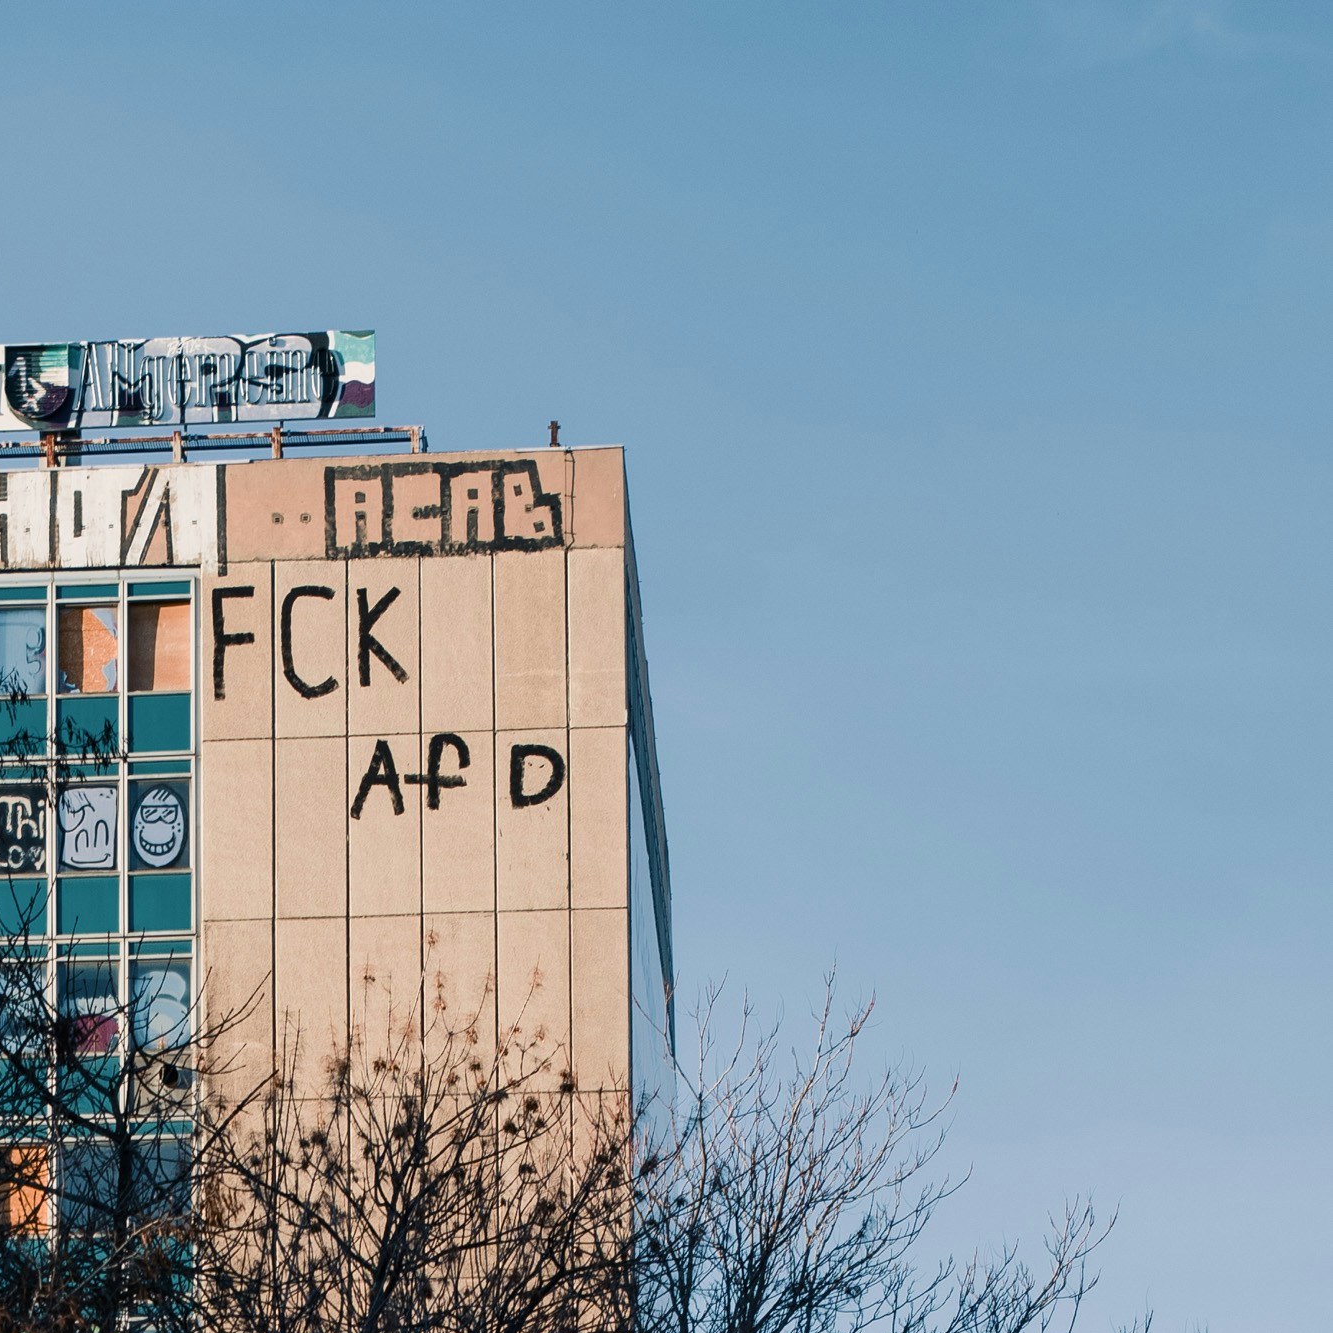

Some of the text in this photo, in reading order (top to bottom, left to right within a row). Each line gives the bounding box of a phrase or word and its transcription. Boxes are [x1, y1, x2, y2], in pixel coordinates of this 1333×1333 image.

[73, 337, 338, 421] Allgemeine
[212, 585, 410, 701] FCK
[350, 732, 566, 821] AfD
